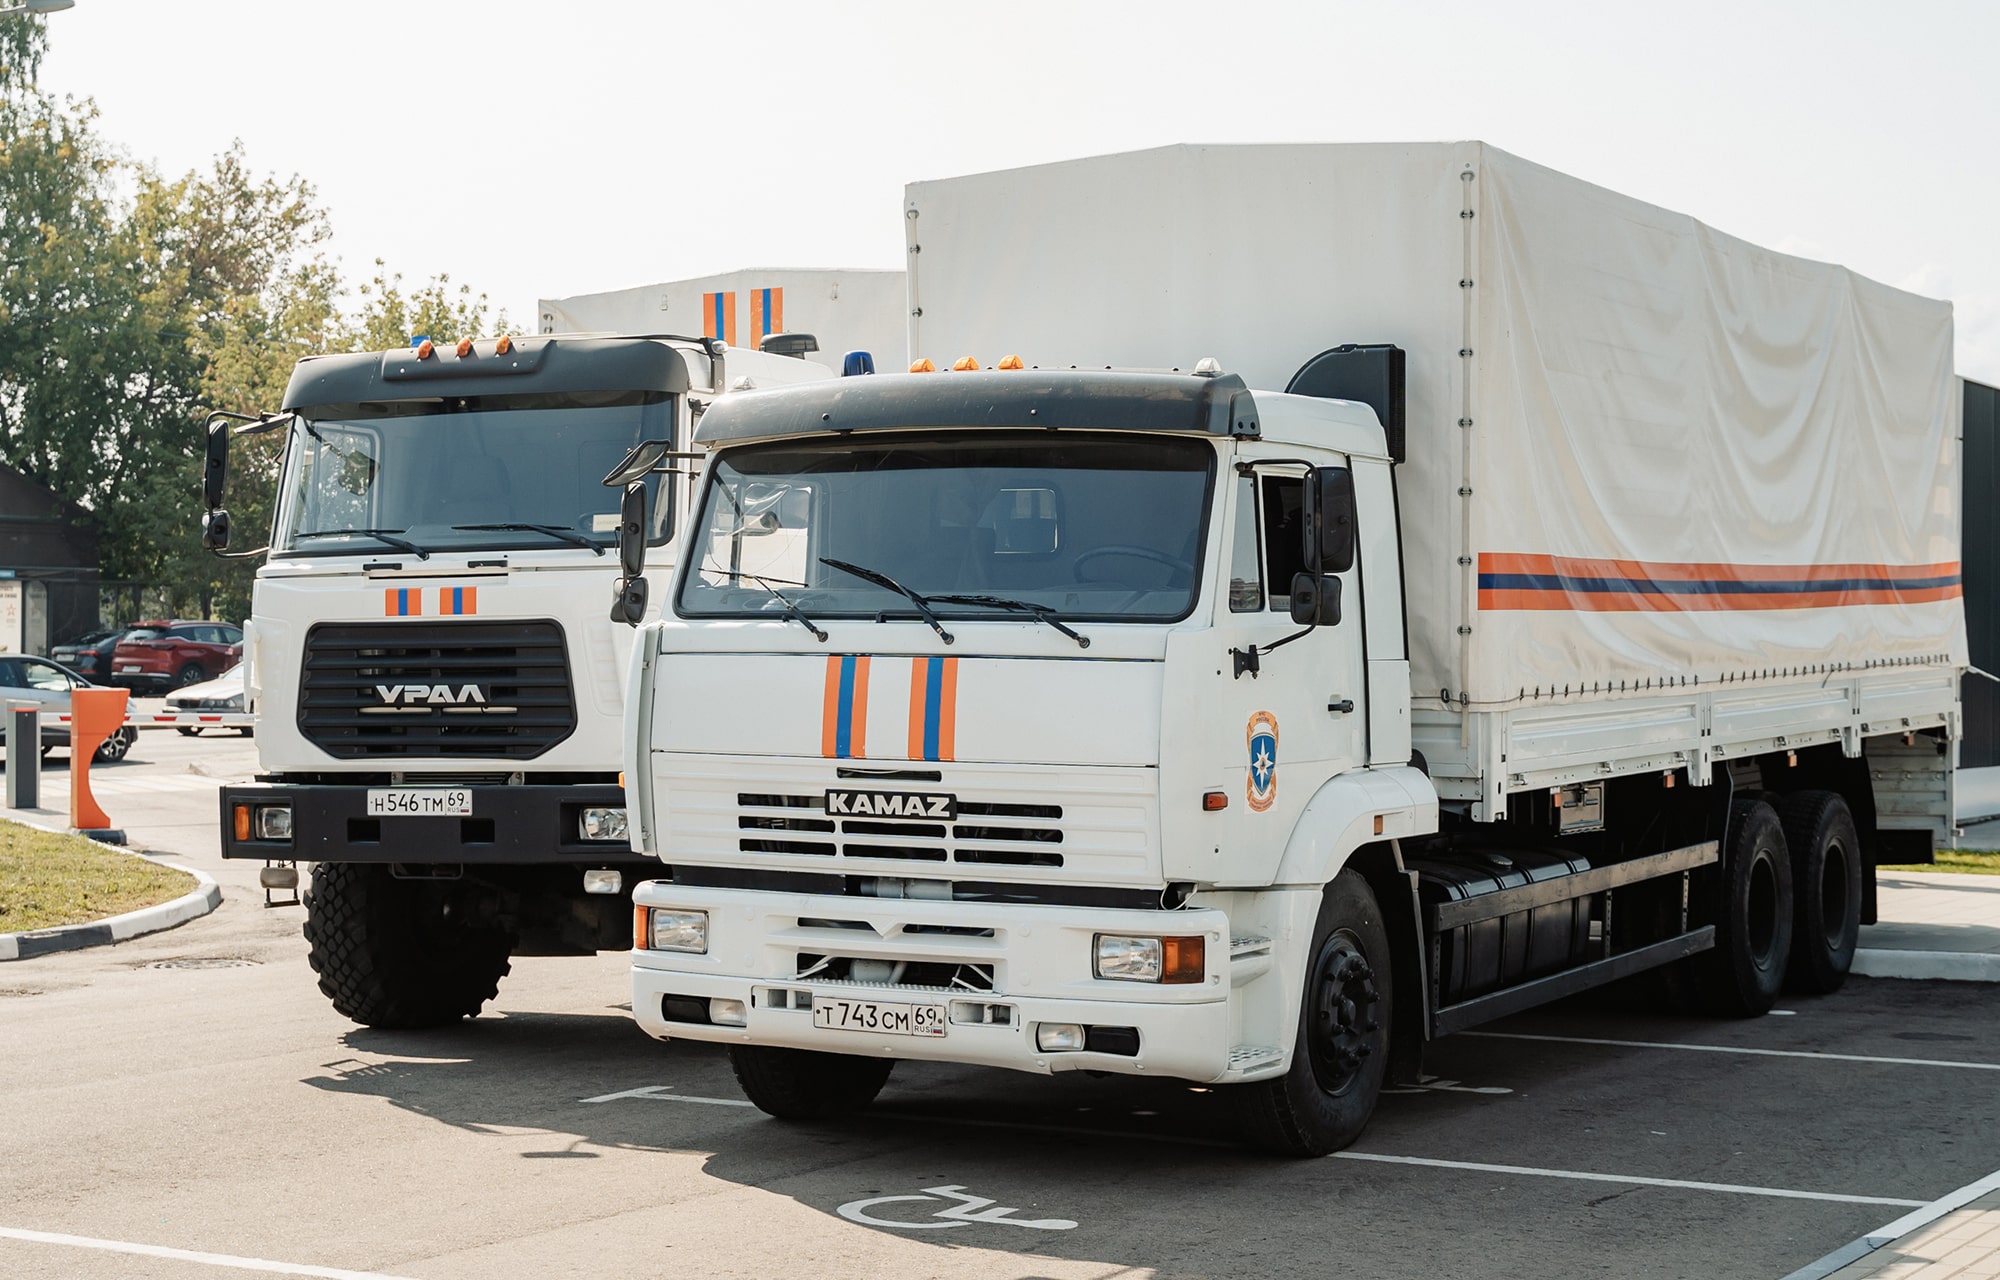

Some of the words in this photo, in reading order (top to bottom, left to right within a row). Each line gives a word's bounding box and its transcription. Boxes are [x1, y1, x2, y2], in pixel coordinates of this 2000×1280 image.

[376, 684, 486, 703] УРАЛ
[447, 792, 465, 806] 69
[829, 793, 950, 817] KAMAZ
[915, 1007, 936, 1026] 69
[914, 1025, 930, 1034] RUS
